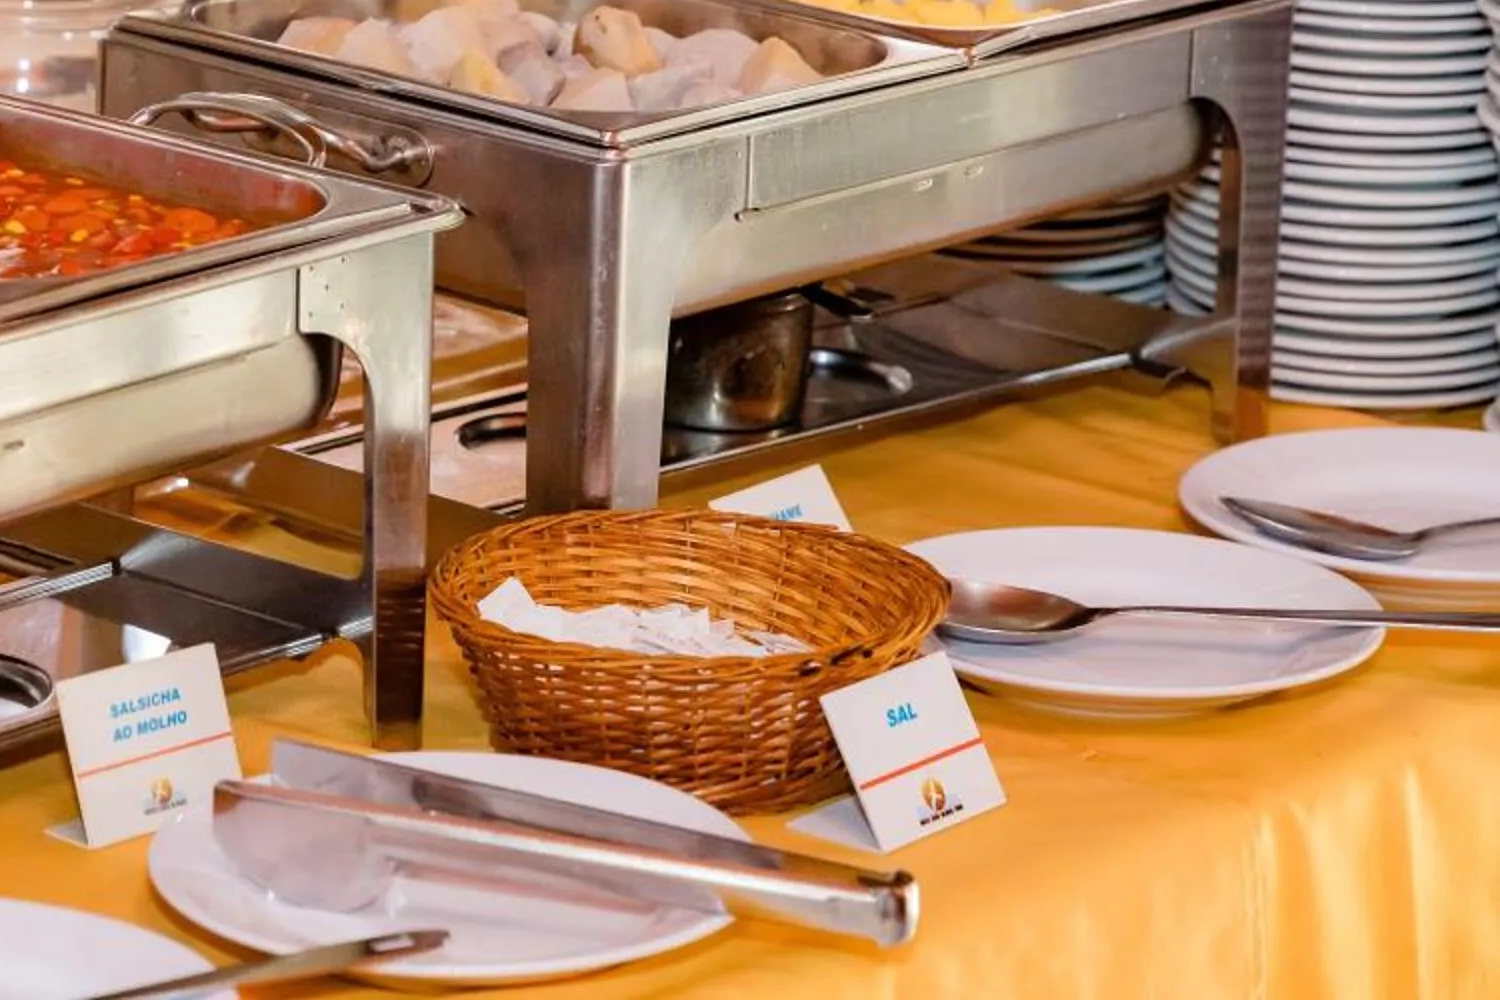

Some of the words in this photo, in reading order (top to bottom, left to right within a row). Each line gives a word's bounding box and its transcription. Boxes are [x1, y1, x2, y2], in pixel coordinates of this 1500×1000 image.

[109, 687, 181, 718] SALSICHA
[886, 702, 917, 728] SAL
[113, 725, 133, 742] AO
[137, 710, 187, 735] MOLHO
